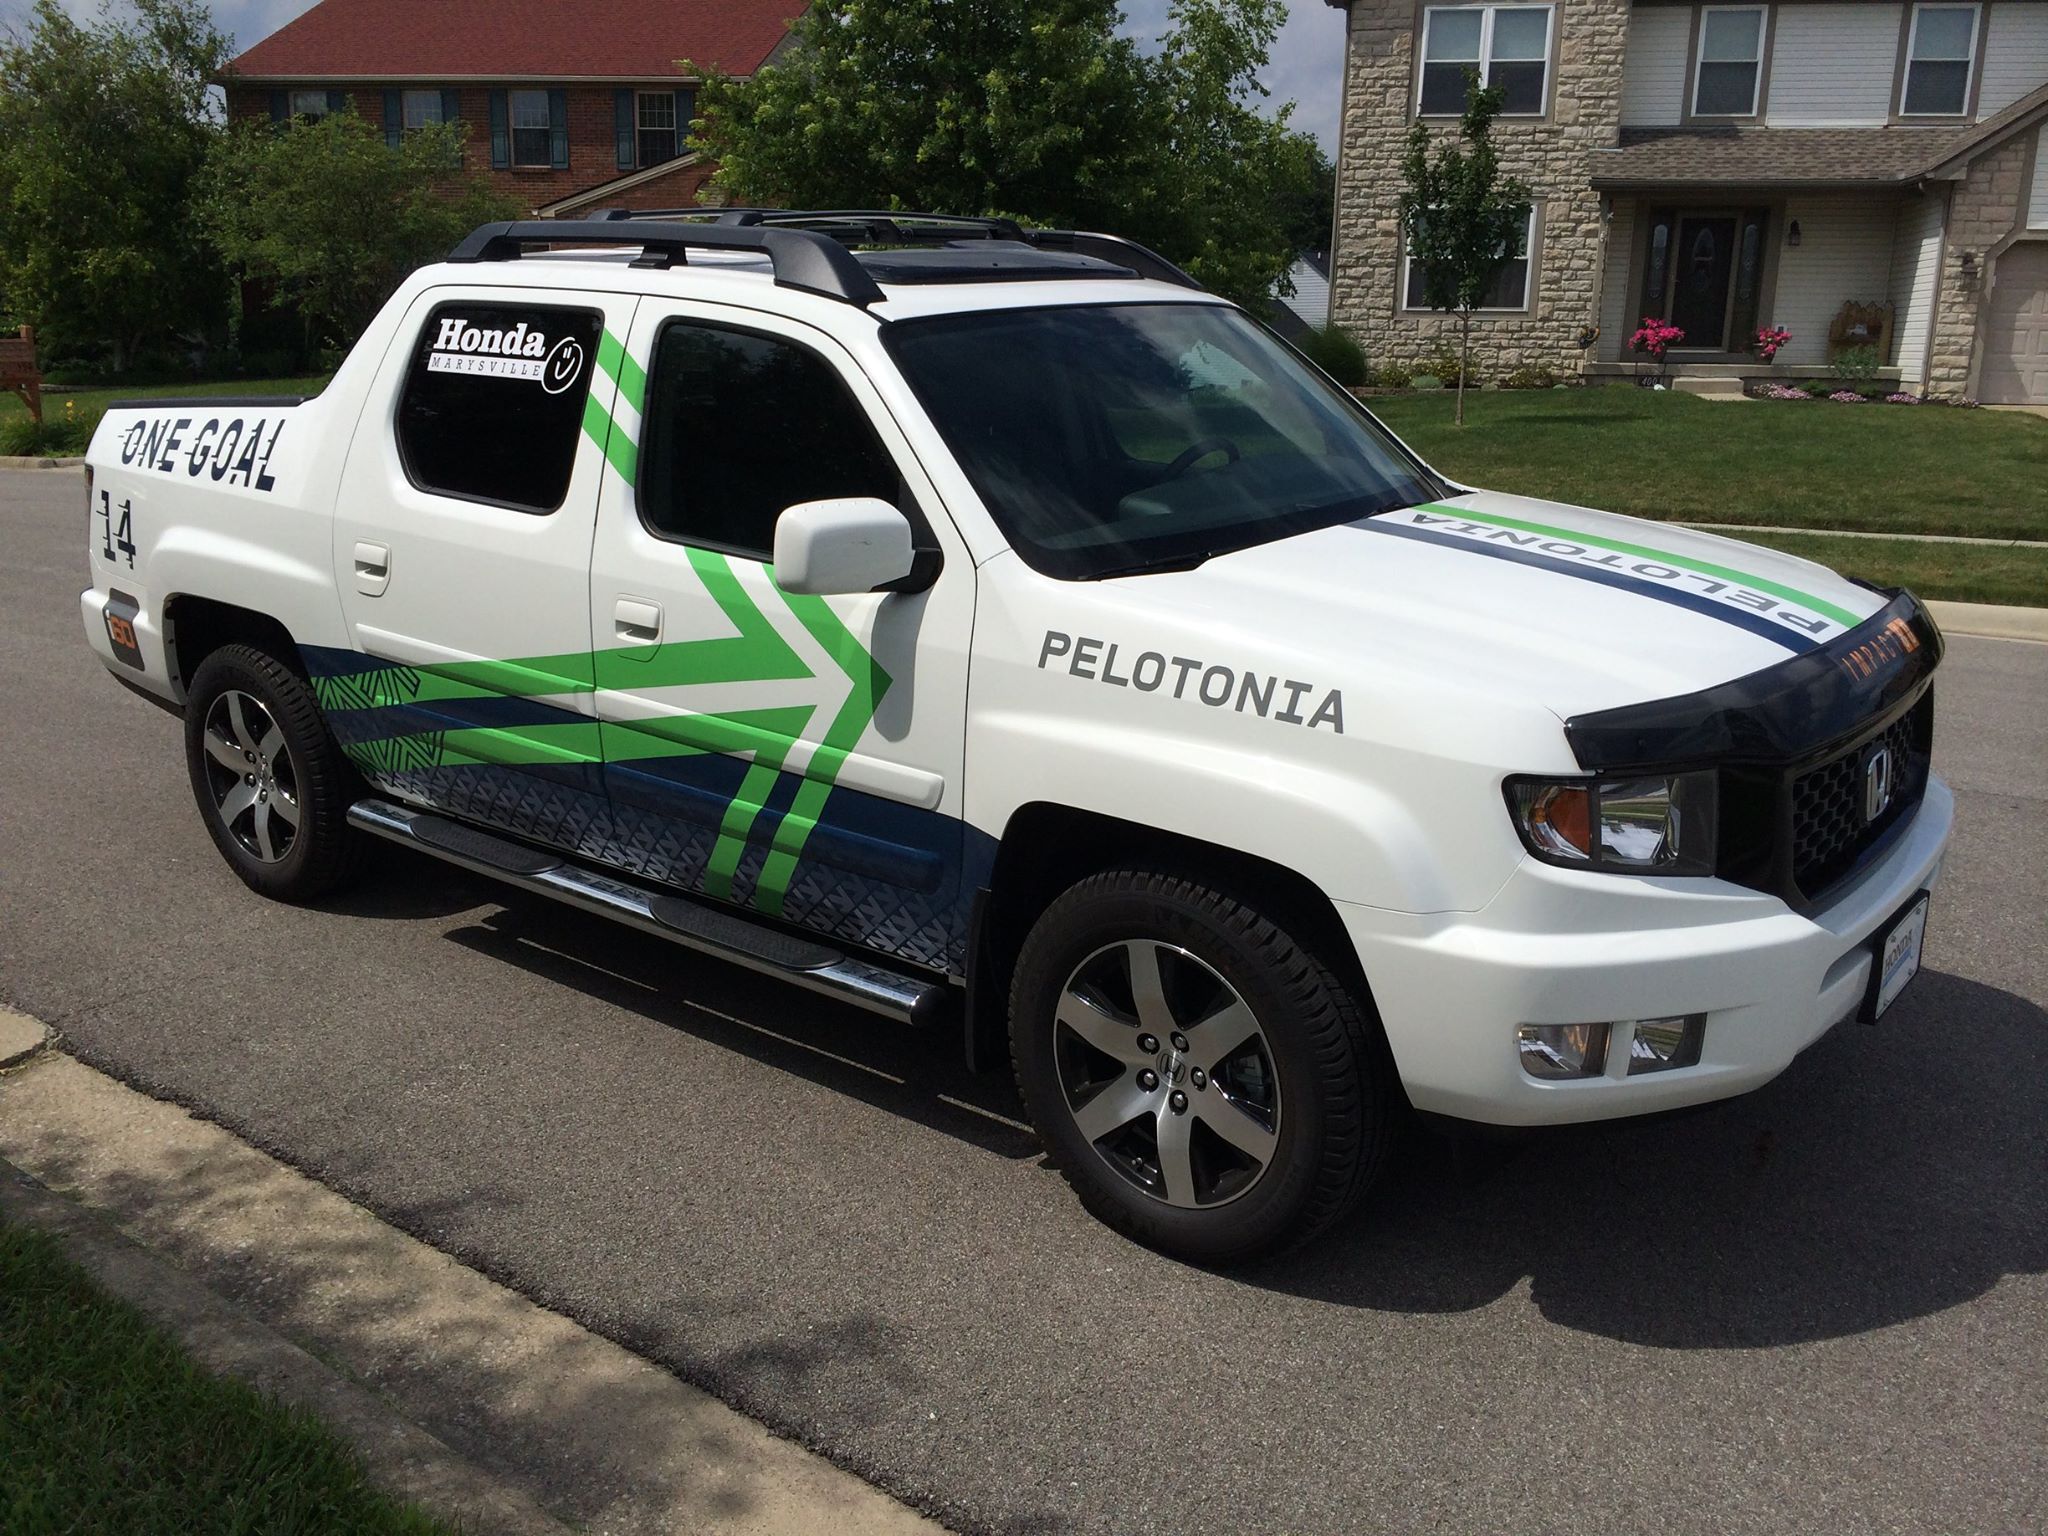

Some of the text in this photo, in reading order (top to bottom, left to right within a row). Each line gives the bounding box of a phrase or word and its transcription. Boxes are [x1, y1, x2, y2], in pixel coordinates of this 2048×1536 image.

[431, 356, 542, 377] MARYSVILLE
[432, 318, 546, 358] Honda
[120, 418, 286, 492] ONE GOAL
[97, 489, 136, 570] 14
[1411, 513, 1830, 635] PELOTONIA
[1037, 629, 1345, 735] PELOTONIA
